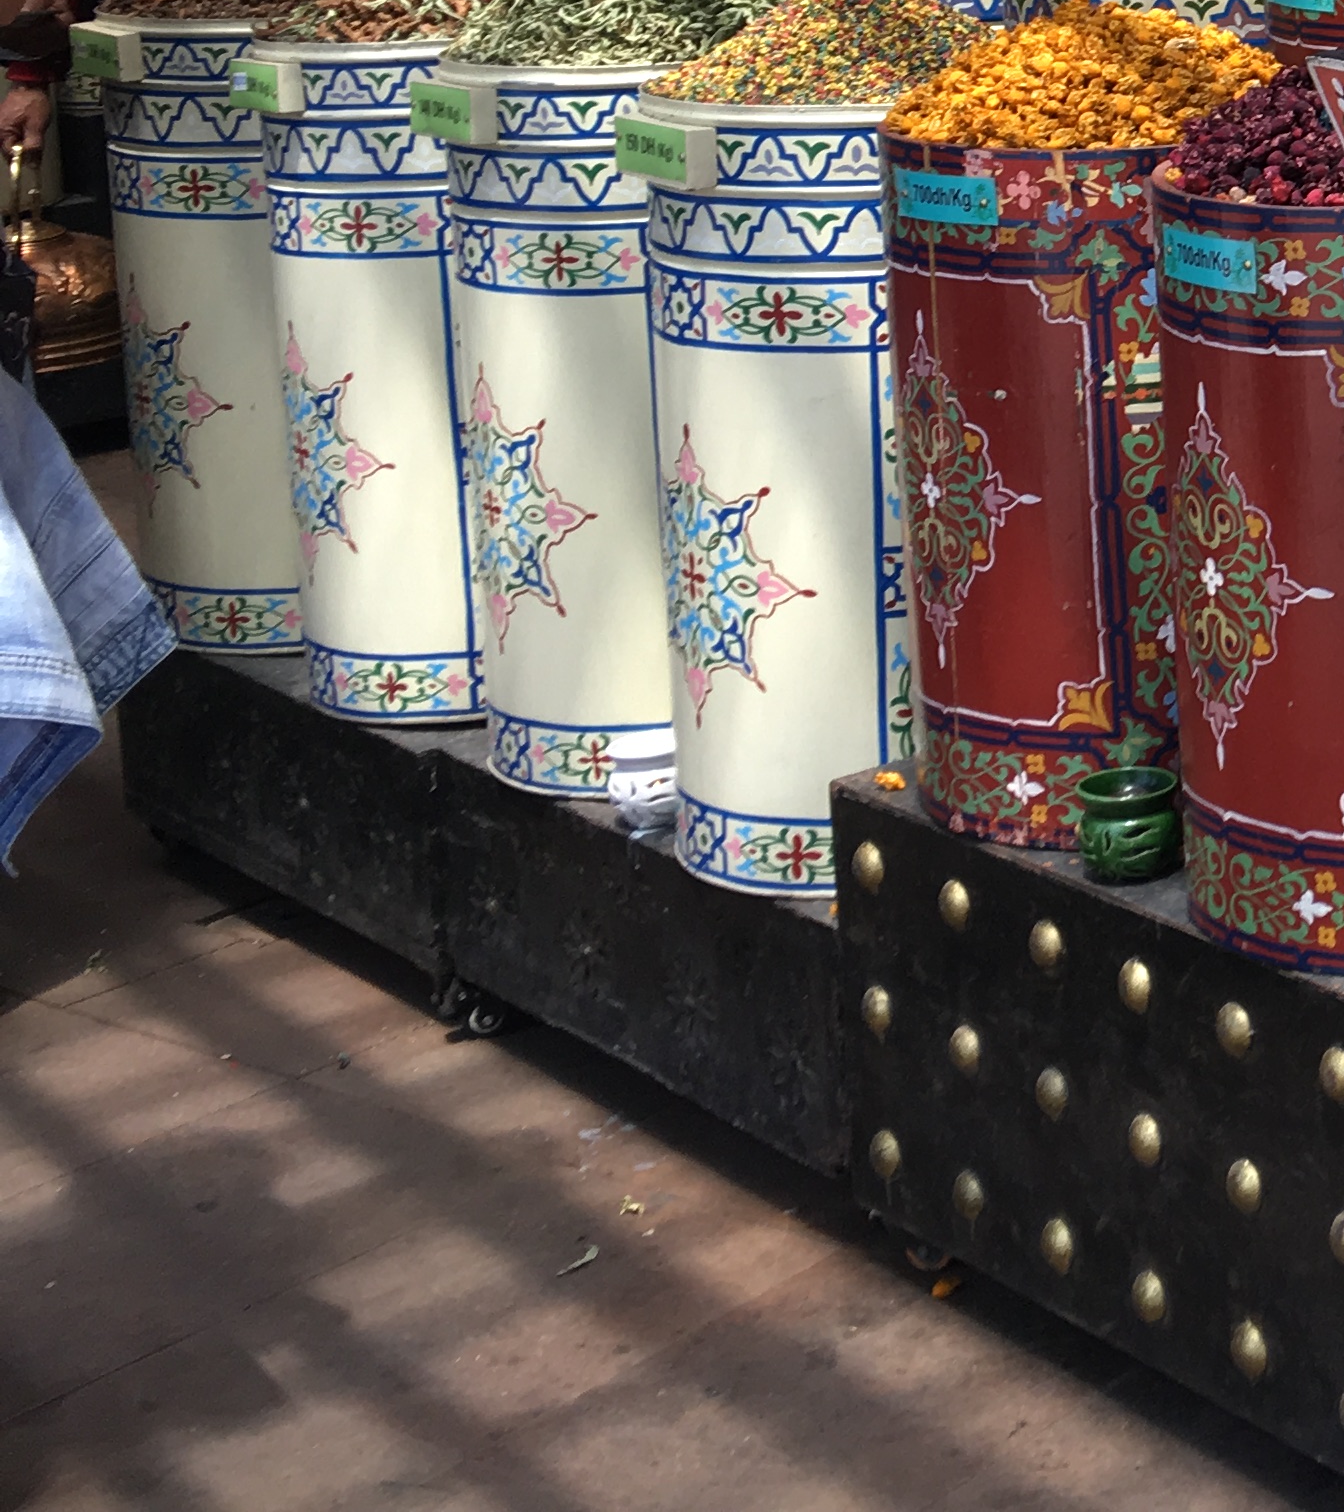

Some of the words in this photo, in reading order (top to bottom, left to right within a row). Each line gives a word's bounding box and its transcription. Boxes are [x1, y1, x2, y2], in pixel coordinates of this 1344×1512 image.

[641, 135, 655, 155] DH
[913, 184, 971, 212] 700dh/Kg
[1177, 242, 1231, 278] 700dh/Kg
